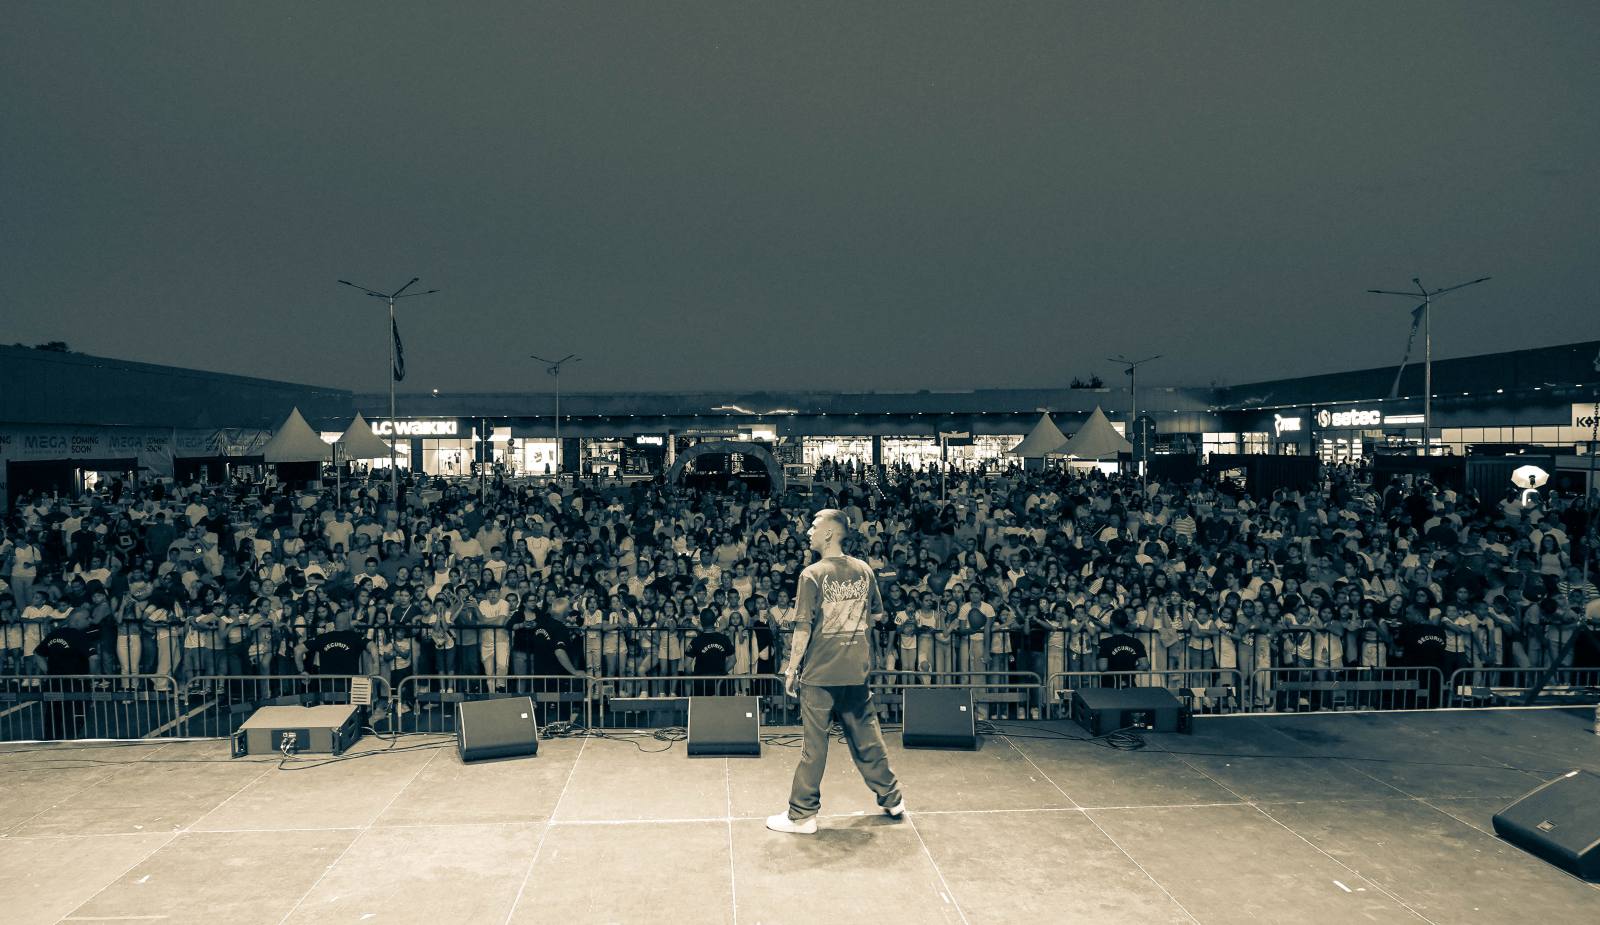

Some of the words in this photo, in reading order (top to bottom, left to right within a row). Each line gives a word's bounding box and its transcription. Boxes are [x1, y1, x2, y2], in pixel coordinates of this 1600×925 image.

[1331, 409, 1381, 426] setec
[371, 421, 392, 435] LC
[25, 435, 67, 448] MEGA
[71, 435, 99, 444] COMING
[108, 436, 143, 448] MEGA
[71, 445, 92, 454] SOON
[323, 641, 350, 652] SECURITY
[701, 643, 725, 654] SECURITY
[1111, 645, 1137, 656] SECURITY
